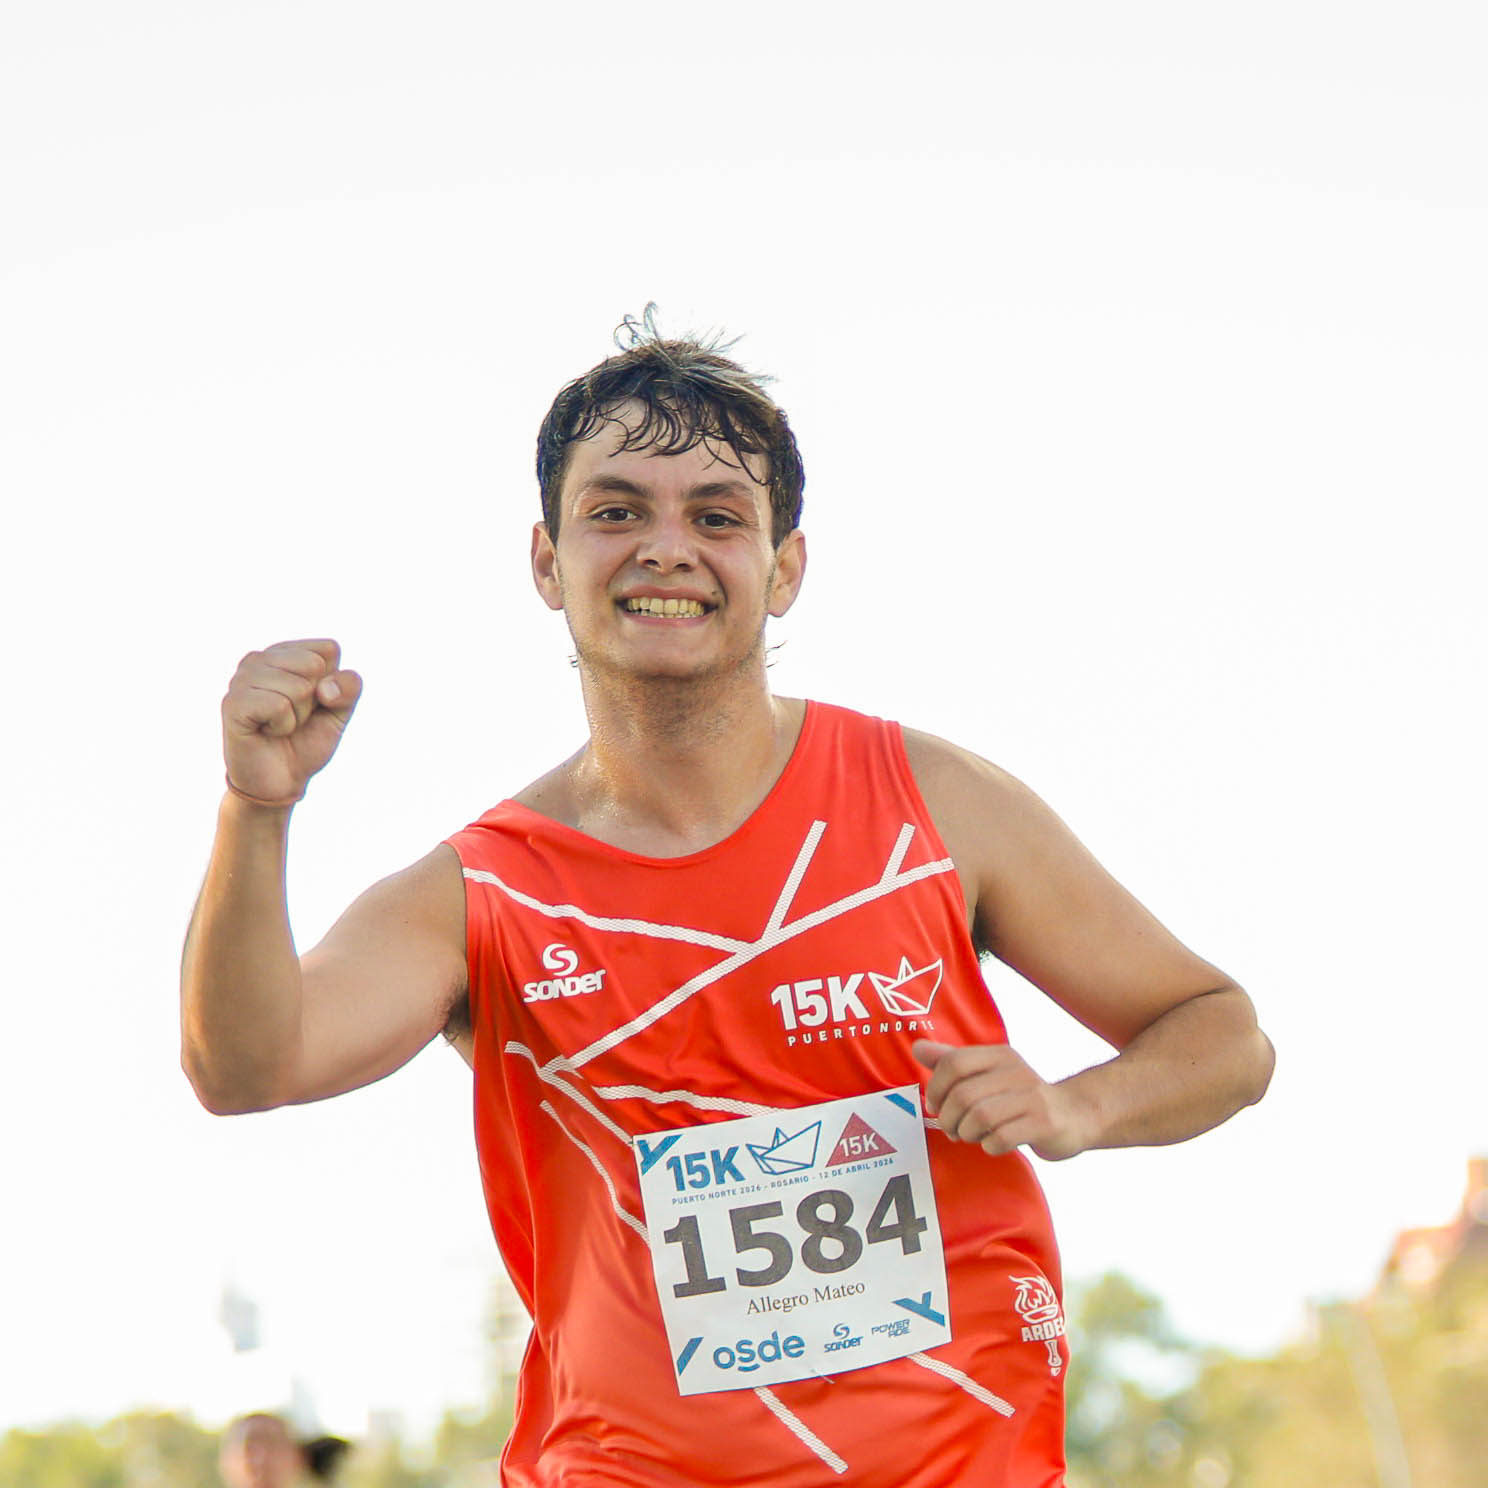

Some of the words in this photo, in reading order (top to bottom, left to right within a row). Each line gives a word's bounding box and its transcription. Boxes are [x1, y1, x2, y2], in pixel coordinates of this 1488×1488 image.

[771, 973, 870, 1031] 15K
[787, 1024, 871, 1046] PUERTO
[879, 1020, 935, 1033] NORTE
[838, 1132, 880, 1158] 15K
[665, 1145, 746, 1192] 15K
[672, 1194, 706, 1205] PUERTO
[708, 1189, 737, 1200] NORTE
[740, 1184, 761, 1195] 2026
[770, 1175, 809, 1189] ROSARIO
[832, 1168, 842, 1177] DE
[846, 1163, 871, 1174] ABRIL
[874, 1157, 894, 1169] 2026
[664, 1173, 928, 1298] 1584
[747, 1293, 809, 1315] Allegro
[814, 1281, 865, 1303] Mateo
[871, 1318, 911, 1335] POWER
[1021, 1316, 1065, 1343] ARDE
[713, 1330, 806, 1372] osde
